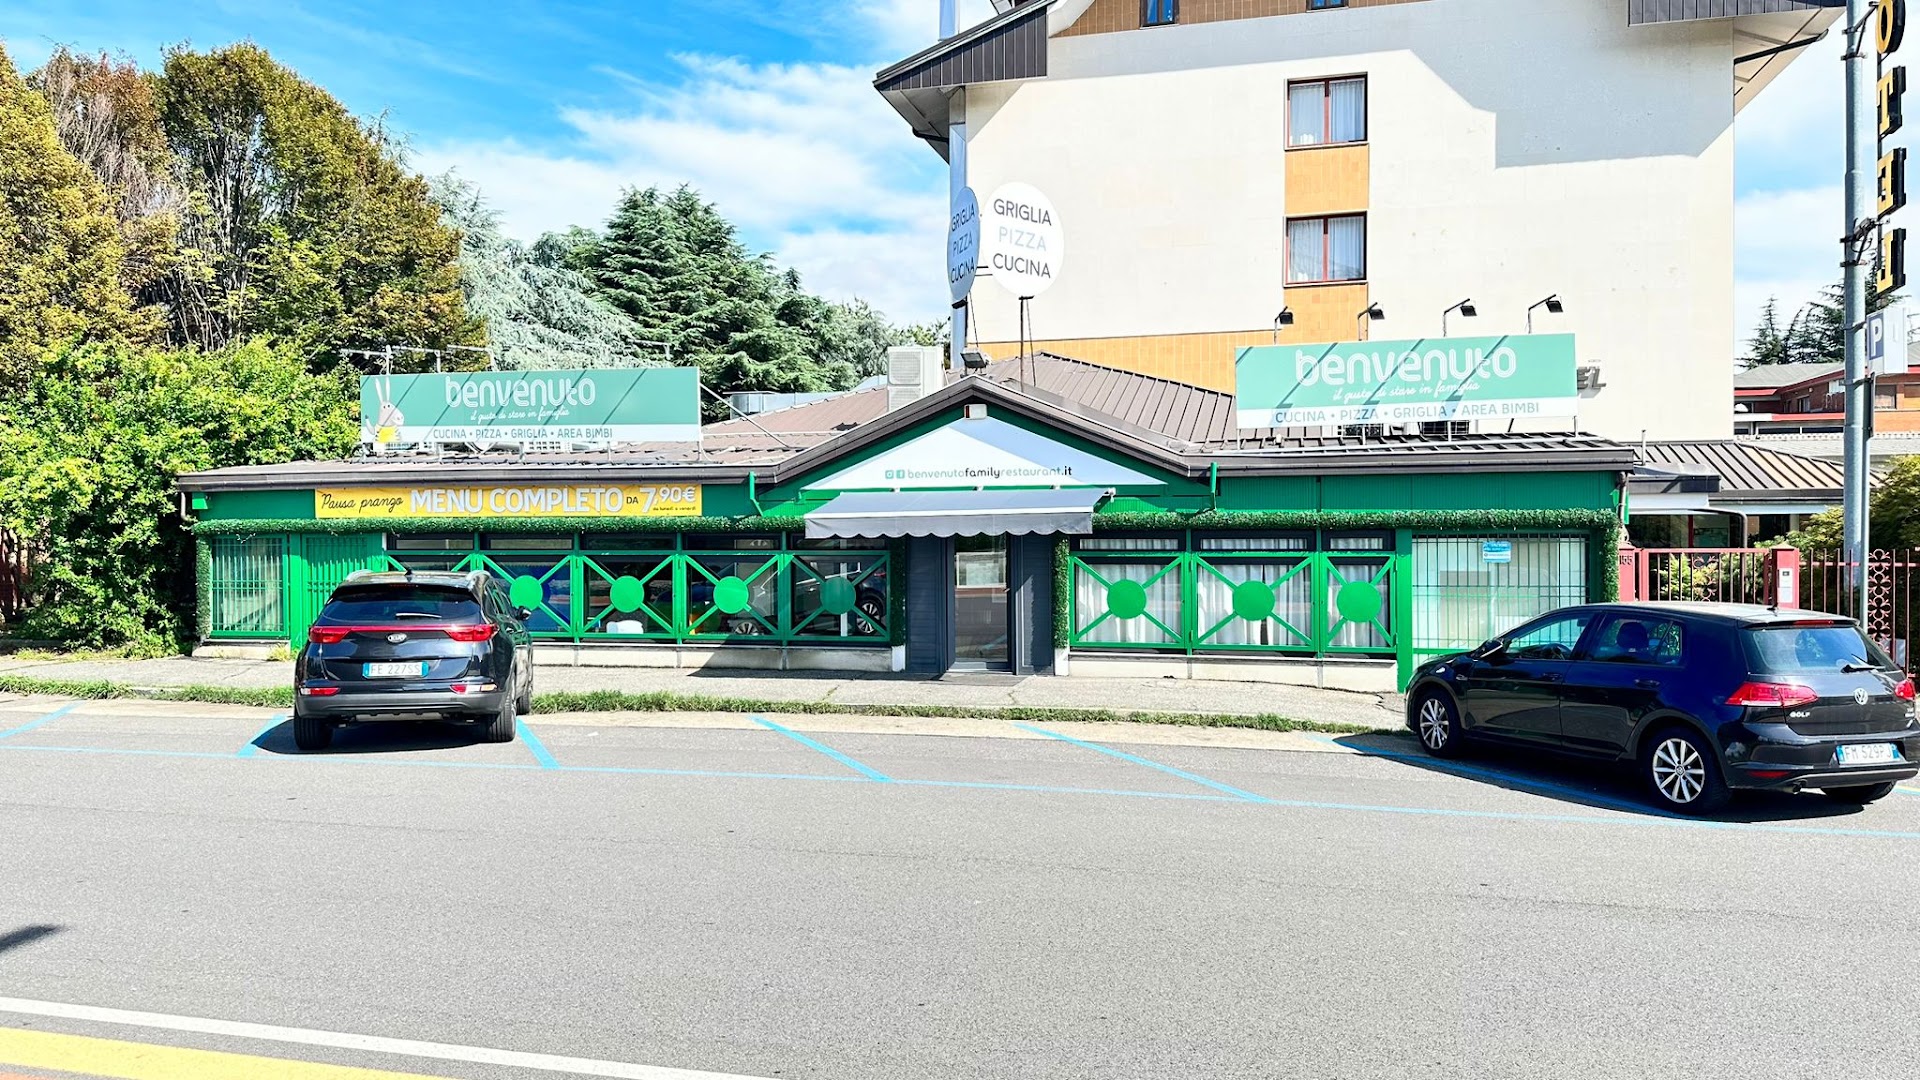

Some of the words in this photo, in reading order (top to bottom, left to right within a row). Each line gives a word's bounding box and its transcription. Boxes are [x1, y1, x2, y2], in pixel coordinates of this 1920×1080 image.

[951, 203, 975, 232] GRIGLIA
[993, 198, 1052, 226] GRIGLIA
[952, 233, 973, 257] PIZZA
[999, 226, 1047, 251] PIZZA
[950, 257, 975, 284] CUCINA
[992, 253, 1051, 279] CUCINA
[1870, 318, 1883, 357] P
[1296, 347, 1516, 386] benvenuto
[445, 376, 595, 407] benvenuto
[1333, 387, 1342, 400] il
[1343, 391, 1373, 404] gusto
[1376, 386, 1386, 397] di
[1389, 386, 1416, 397] stare
[1419, 383, 1433, 394] in
[1433, 379, 1480, 398] famiglia
[1275, 411, 1326, 423] CUCINA
[1341, 408, 1379, 421] PIZZA
[1393, 405, 1448, 418] GRIGLIA
[1461, 404, 1497, 417] AREA
[1502, 402, 1539, 415] BIMBI
[433, 428, 467, 440] CUCINA
[475, 428, 502, 439] PIZZA
[511, 427, 548, 439] GRIGLIA
[557, 427, 583, 438] AREA
[585, 427, 613, 438] BIMBI
[907, 465, 1073, 480] benvenutofamilyrestaurant.it
[321, 493, 356, 509] Pausa
[359, 495, 404, 513] pranzo
[410, 489, 483, 513] MENU
[489, 487, 623, 513] COMPLETO
[640, 487, 695, 513] 7,90€
[371, 664, 383, 675] FE
[388, 664, 421, 675] 227SS
